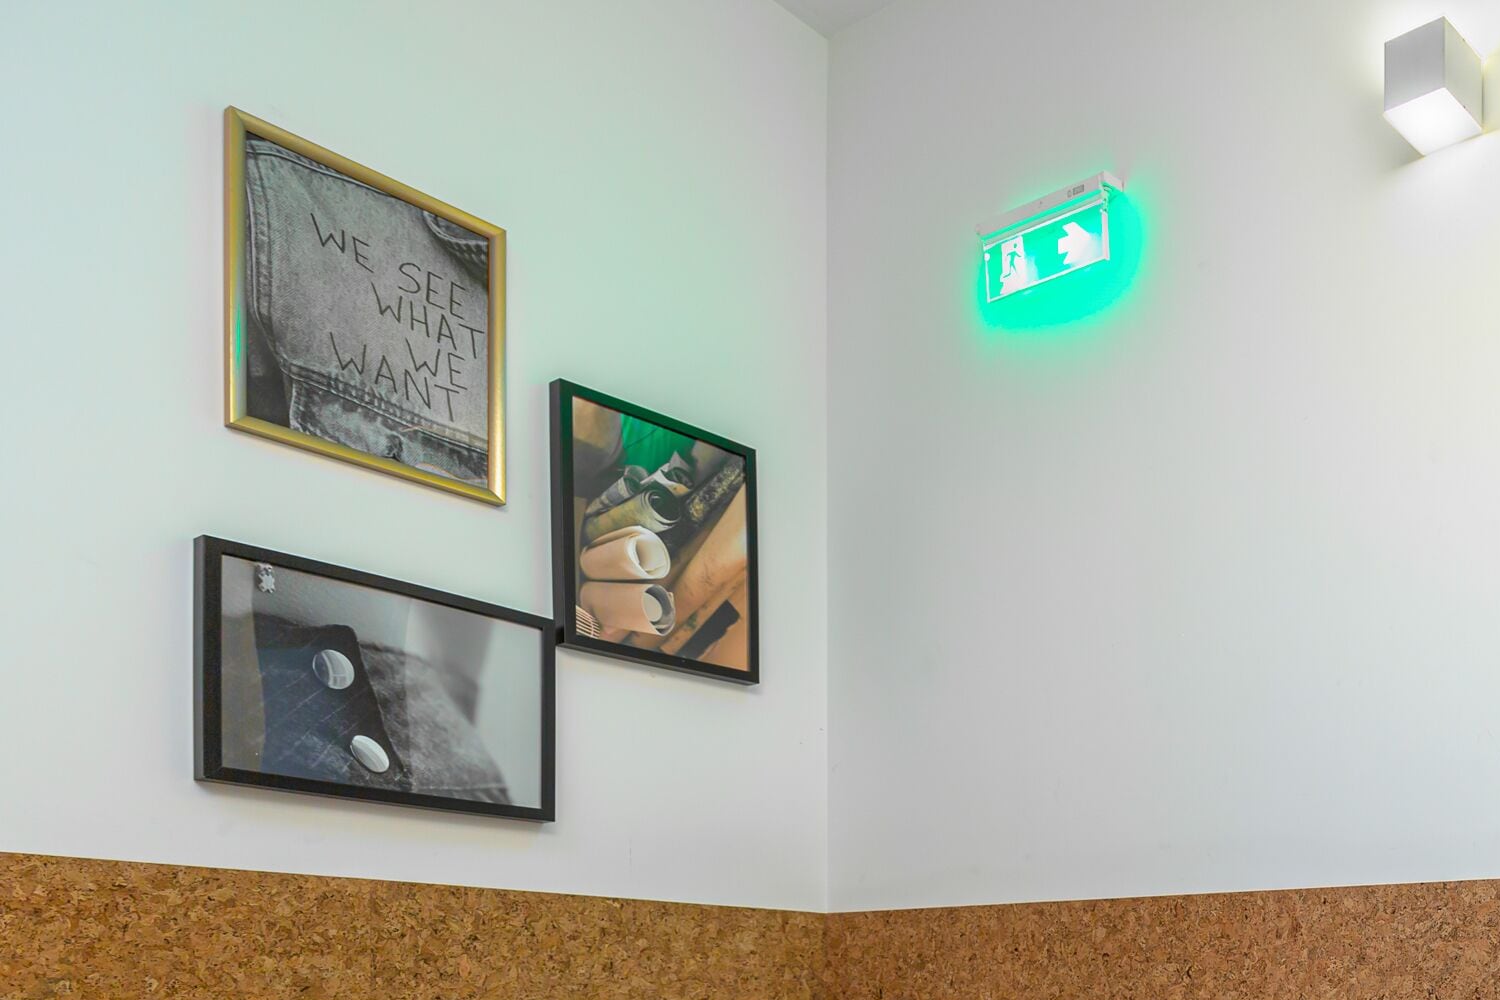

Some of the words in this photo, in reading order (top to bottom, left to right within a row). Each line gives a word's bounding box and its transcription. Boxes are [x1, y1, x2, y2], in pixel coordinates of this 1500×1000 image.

[310, 212, 374, 273] WE
[398, 262, 466, 320] SEE
[371, 281, 485, 359] WHAT
[329, 331, 460, 422] WANT
[405, 337, 468, 390] WE
